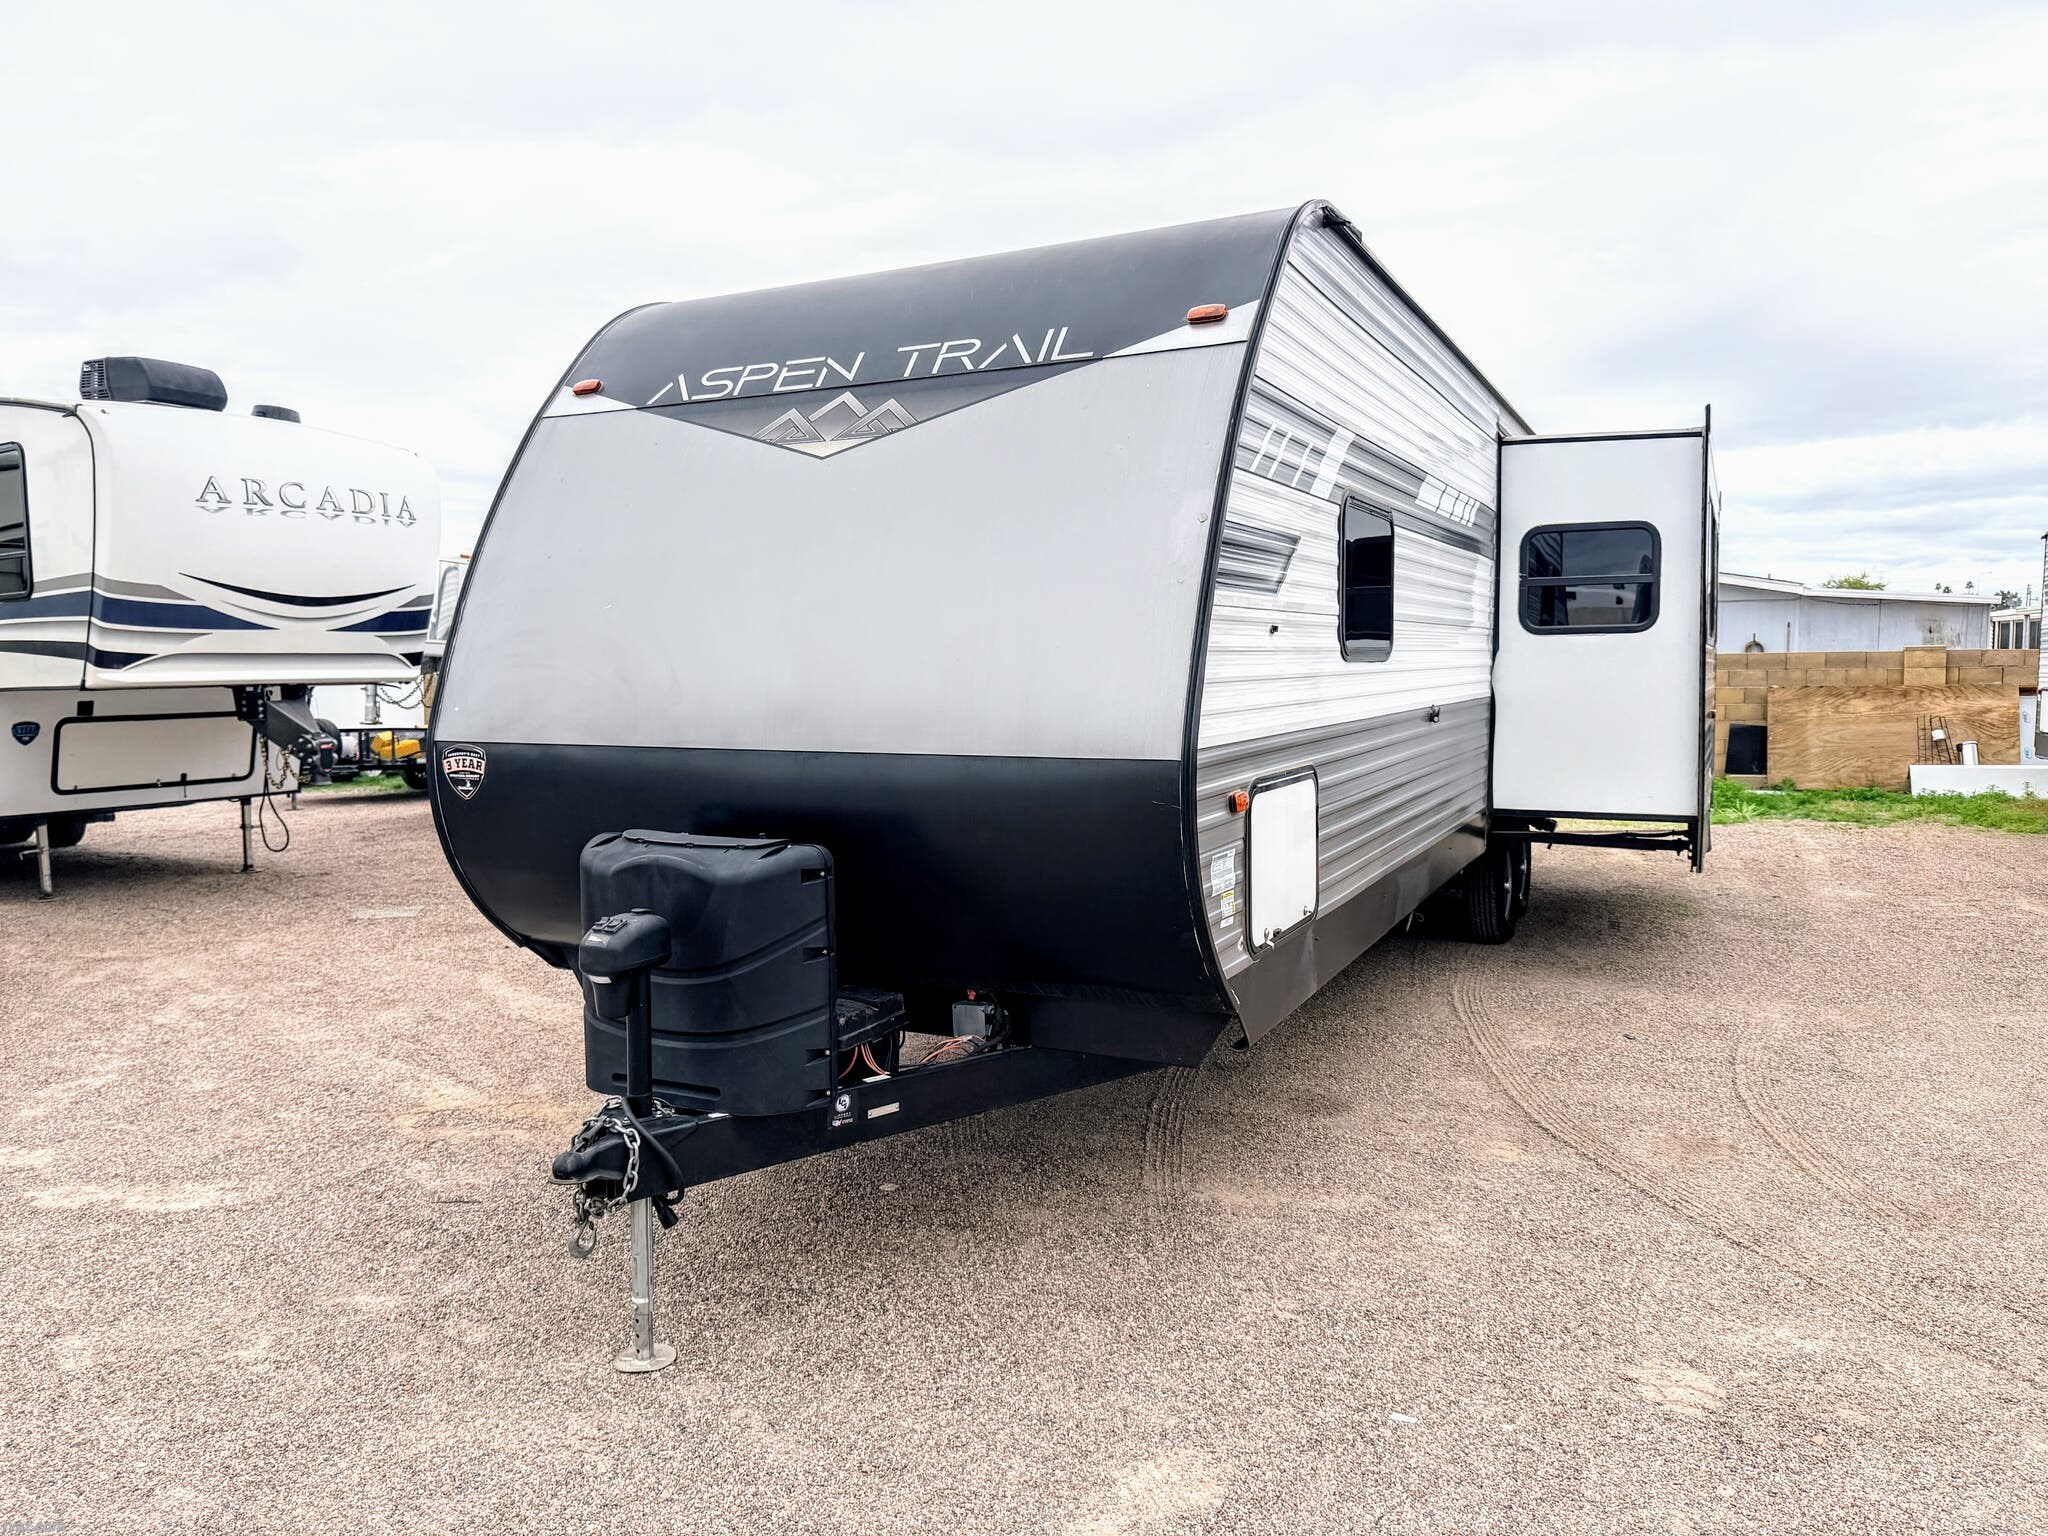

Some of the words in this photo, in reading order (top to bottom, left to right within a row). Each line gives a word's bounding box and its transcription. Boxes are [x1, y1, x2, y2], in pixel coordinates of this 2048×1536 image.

[646, 351, 866, 406] ASPEN
[897, 326, 1095, 378] TRAIL
[195, 475, 417, 521] ARCADIA
[446, 760, 452, 771] 3
[454, 758, 483, 771] YEAR
